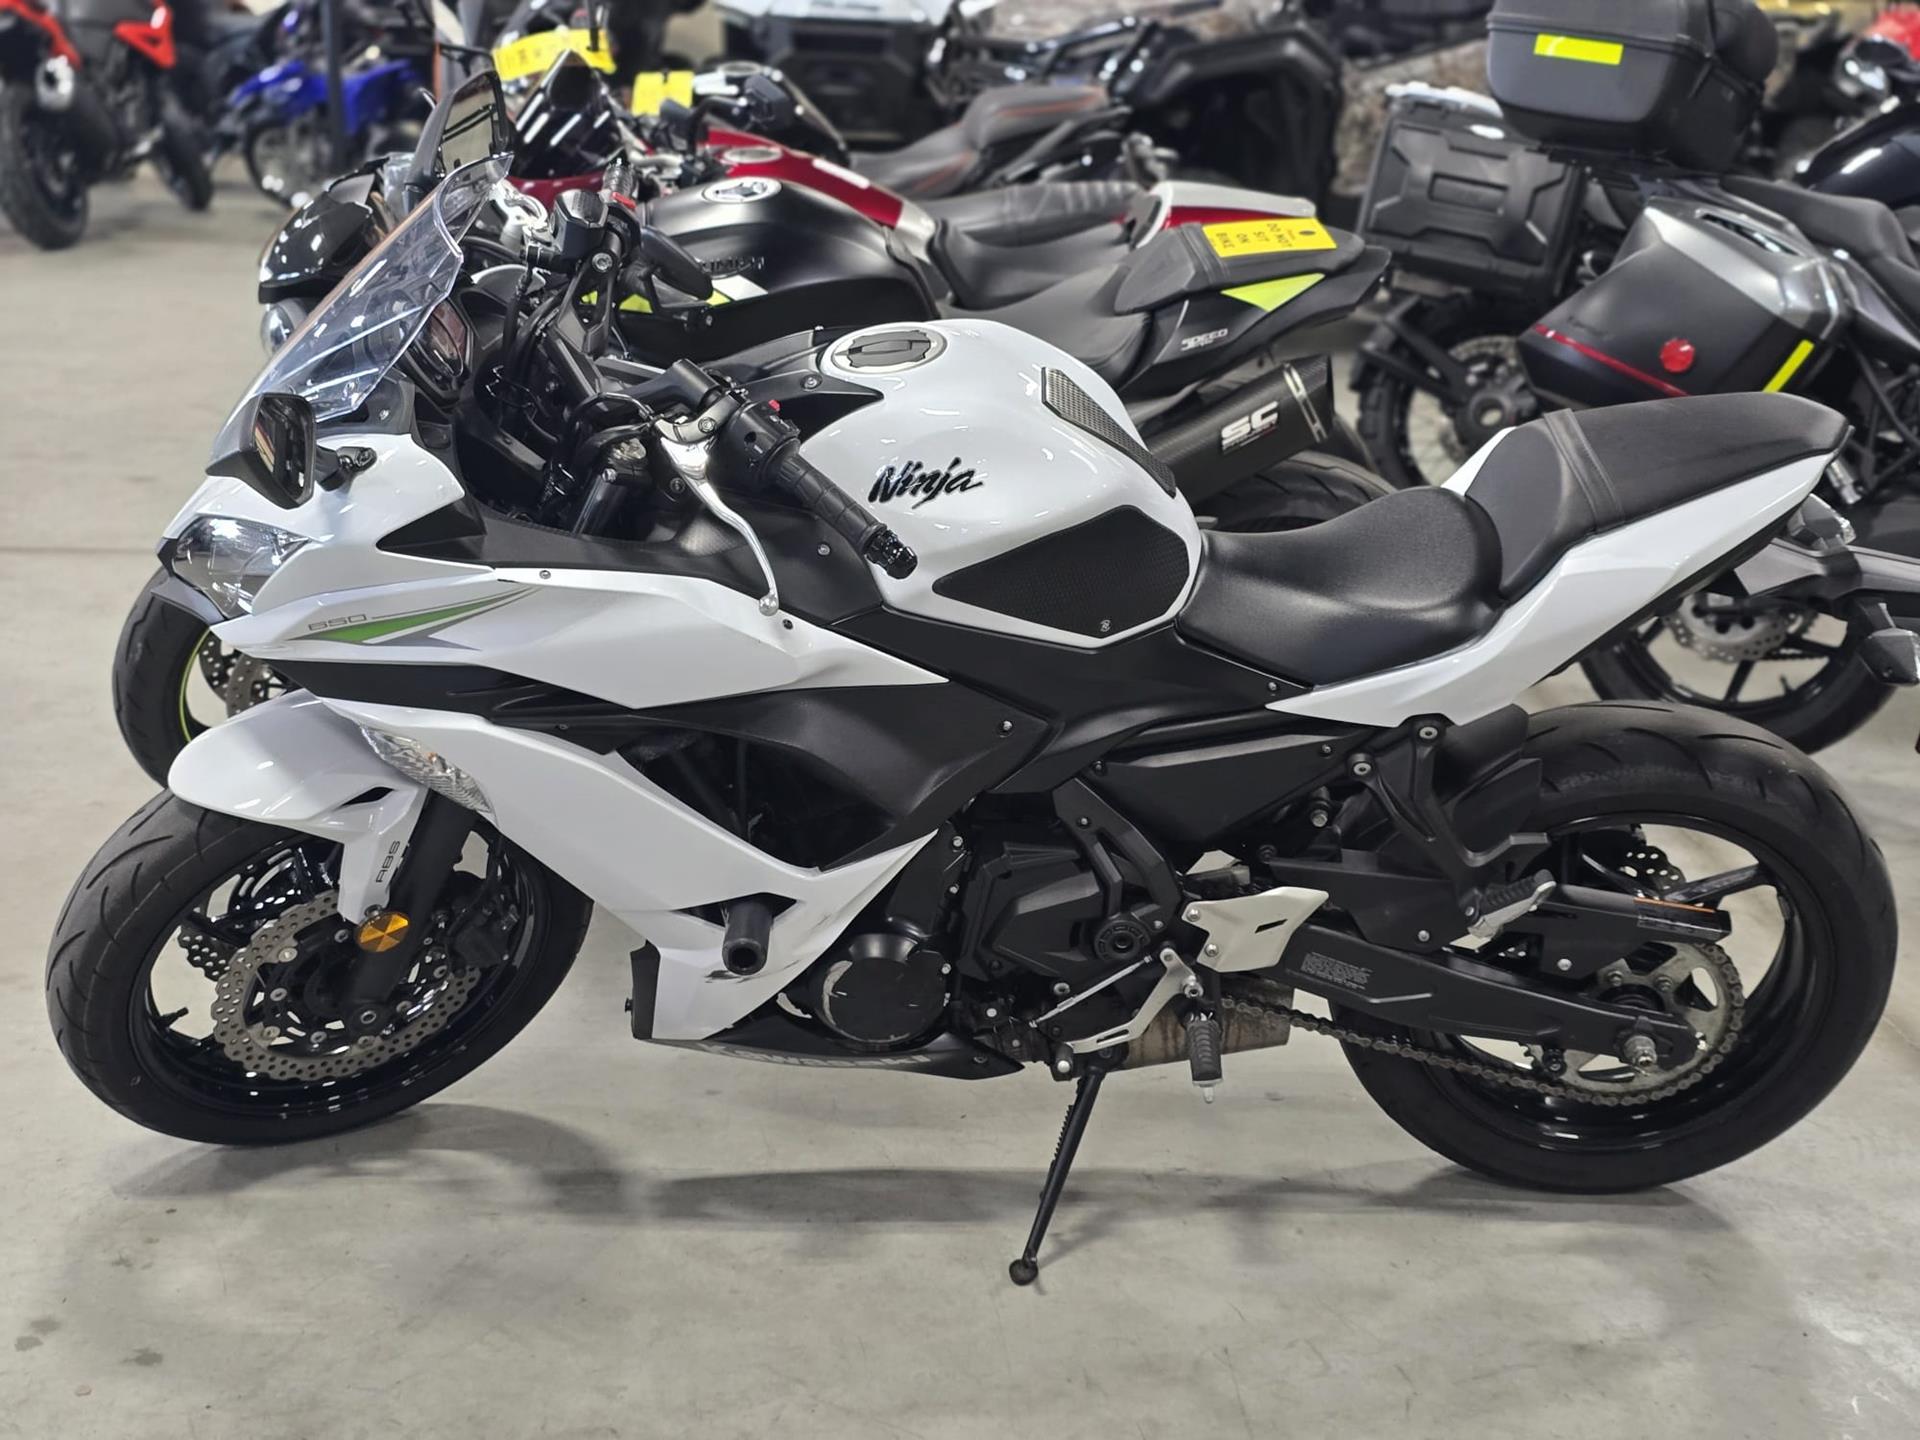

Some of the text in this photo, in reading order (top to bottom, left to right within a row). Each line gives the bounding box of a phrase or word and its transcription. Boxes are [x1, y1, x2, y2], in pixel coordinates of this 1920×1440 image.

[1221, 400, 1279, 447] SC
[868, 457, 983, 509] Ninja
[308, 613, 367, 631] 650
[375, 840, 401, 883] ABS
